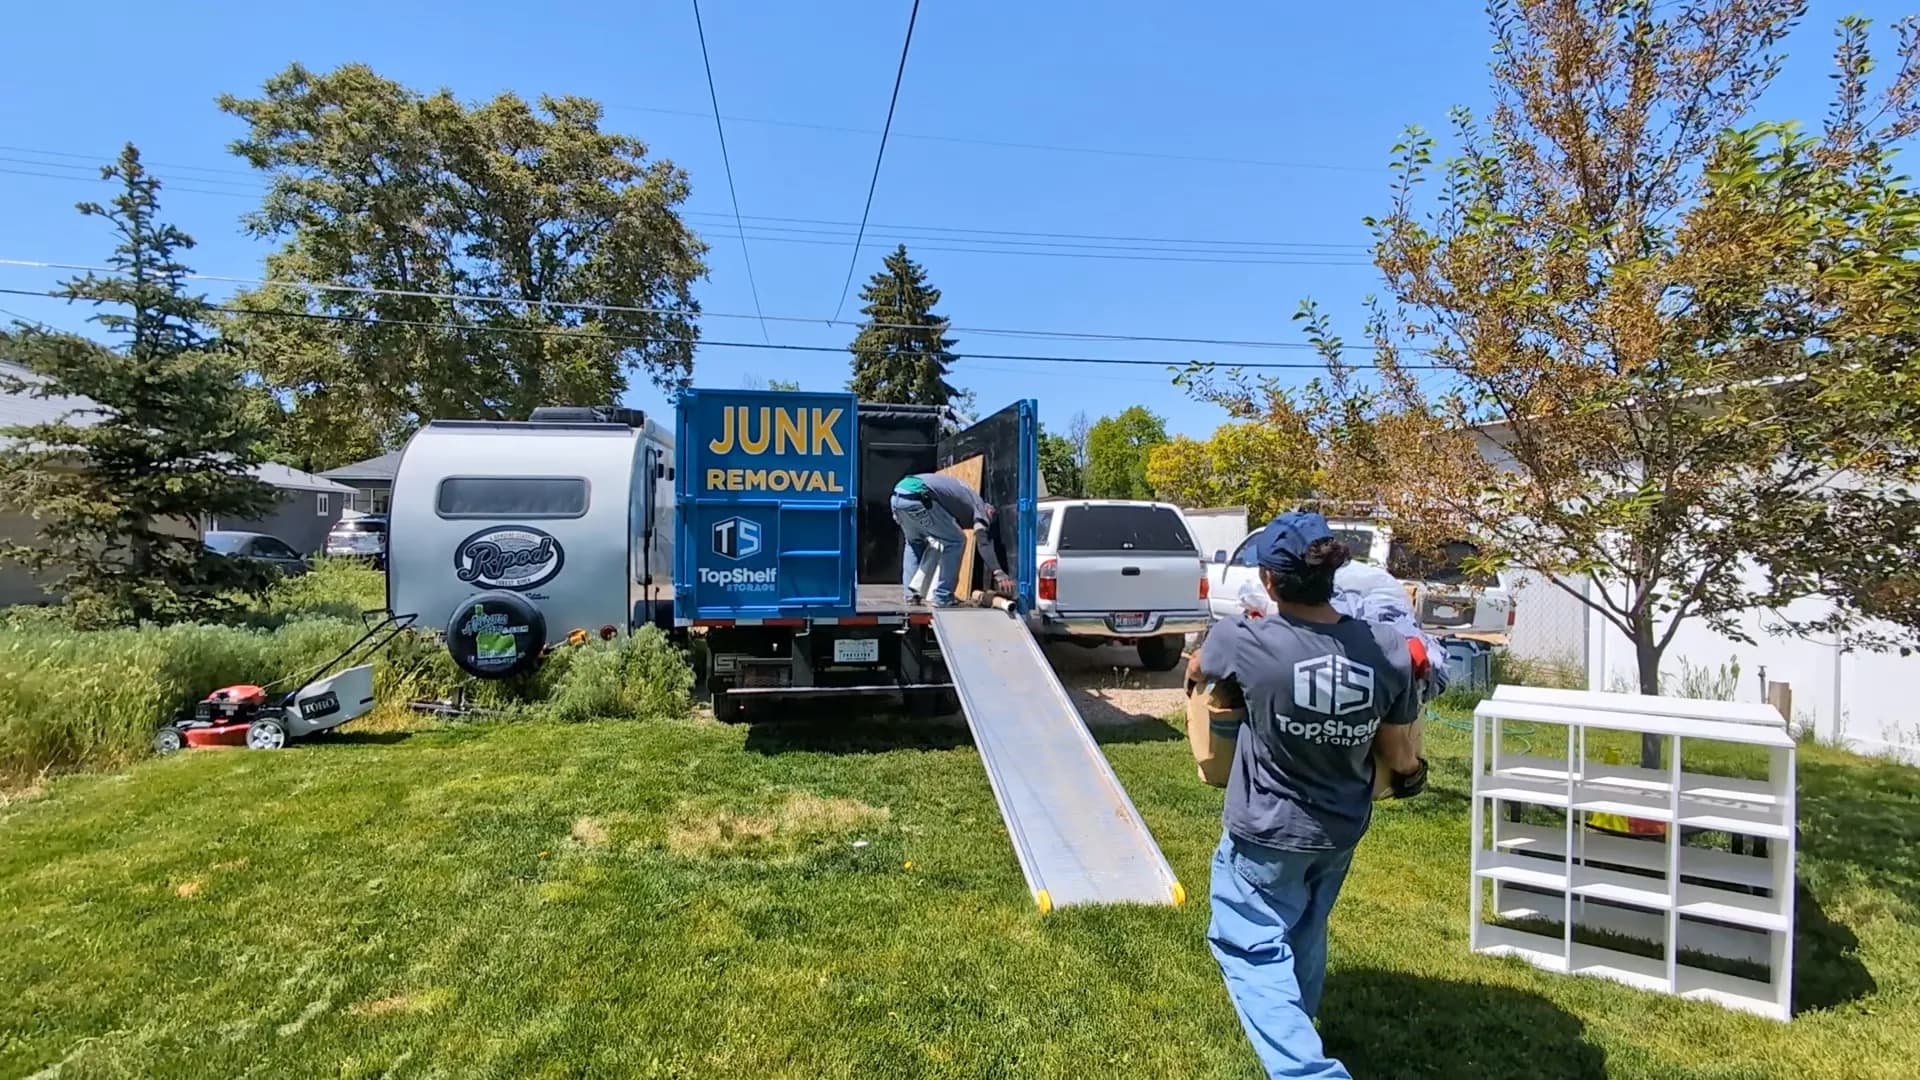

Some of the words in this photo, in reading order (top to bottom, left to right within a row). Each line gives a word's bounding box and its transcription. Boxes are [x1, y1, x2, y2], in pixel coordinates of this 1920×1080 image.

[709, 406, 844, 456] JUNK
[707, 468, 844, 492] REMOVAL
[715, 521, 760, 556] TS
[698, 567, 777, 587] TopShelf
[726, 583, 776, 592] STORAGE
[1298, 660, 1371, 712] TS
[303, 698, 335, 713] TORO
[1276, 713, 1381, 740] TopShelf
